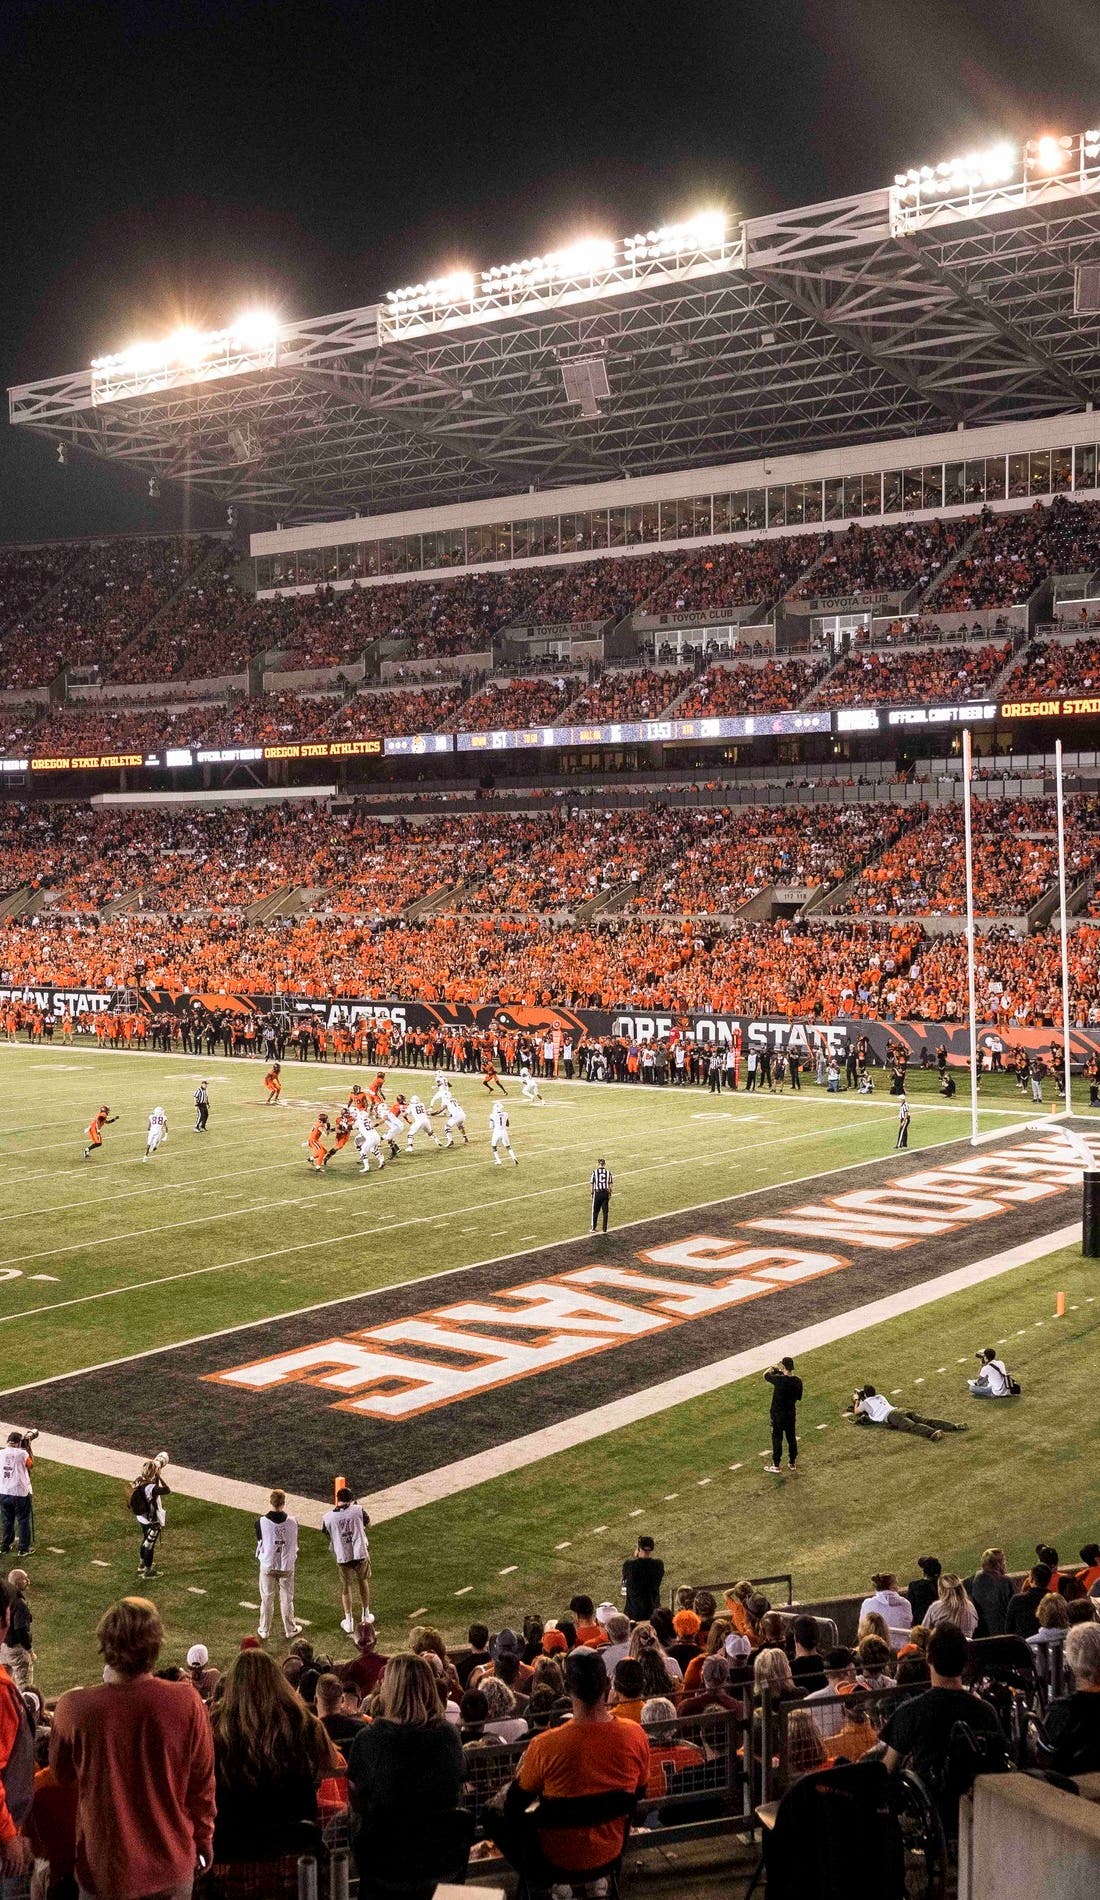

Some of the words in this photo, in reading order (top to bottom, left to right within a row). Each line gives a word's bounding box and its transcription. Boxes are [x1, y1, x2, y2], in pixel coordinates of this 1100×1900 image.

[821, 597, 859, 608] TOYOTA
[863, 594, 888, 605] CLUB
[672, 612, 707, 623] TOYOTA
[709, 609, 733, 619] CLUB
[536, 625, 568, 636] TOYOTA
[570, 622, 592, 632] CLUB
[1001, 702, 1060, 718] OREGON
[264, 746, 299, 758] OREGON
[301, 744, 328, 756] STATE
[329, 741, 380, 755] ATHLETICS
[31, 758, 69, 769] OREGON
[71, 757, 99, 768] STATE
[100, 755, 142, 767] ATHLETICS
[612, 1016, 740, 1045] OREON
[747, 1022, 847, 1056] STATE
[151, 1116, 164, 1125] 88
[598, 1172, 606, 1183] C
[201, 1235, 854, 1422] STATE
